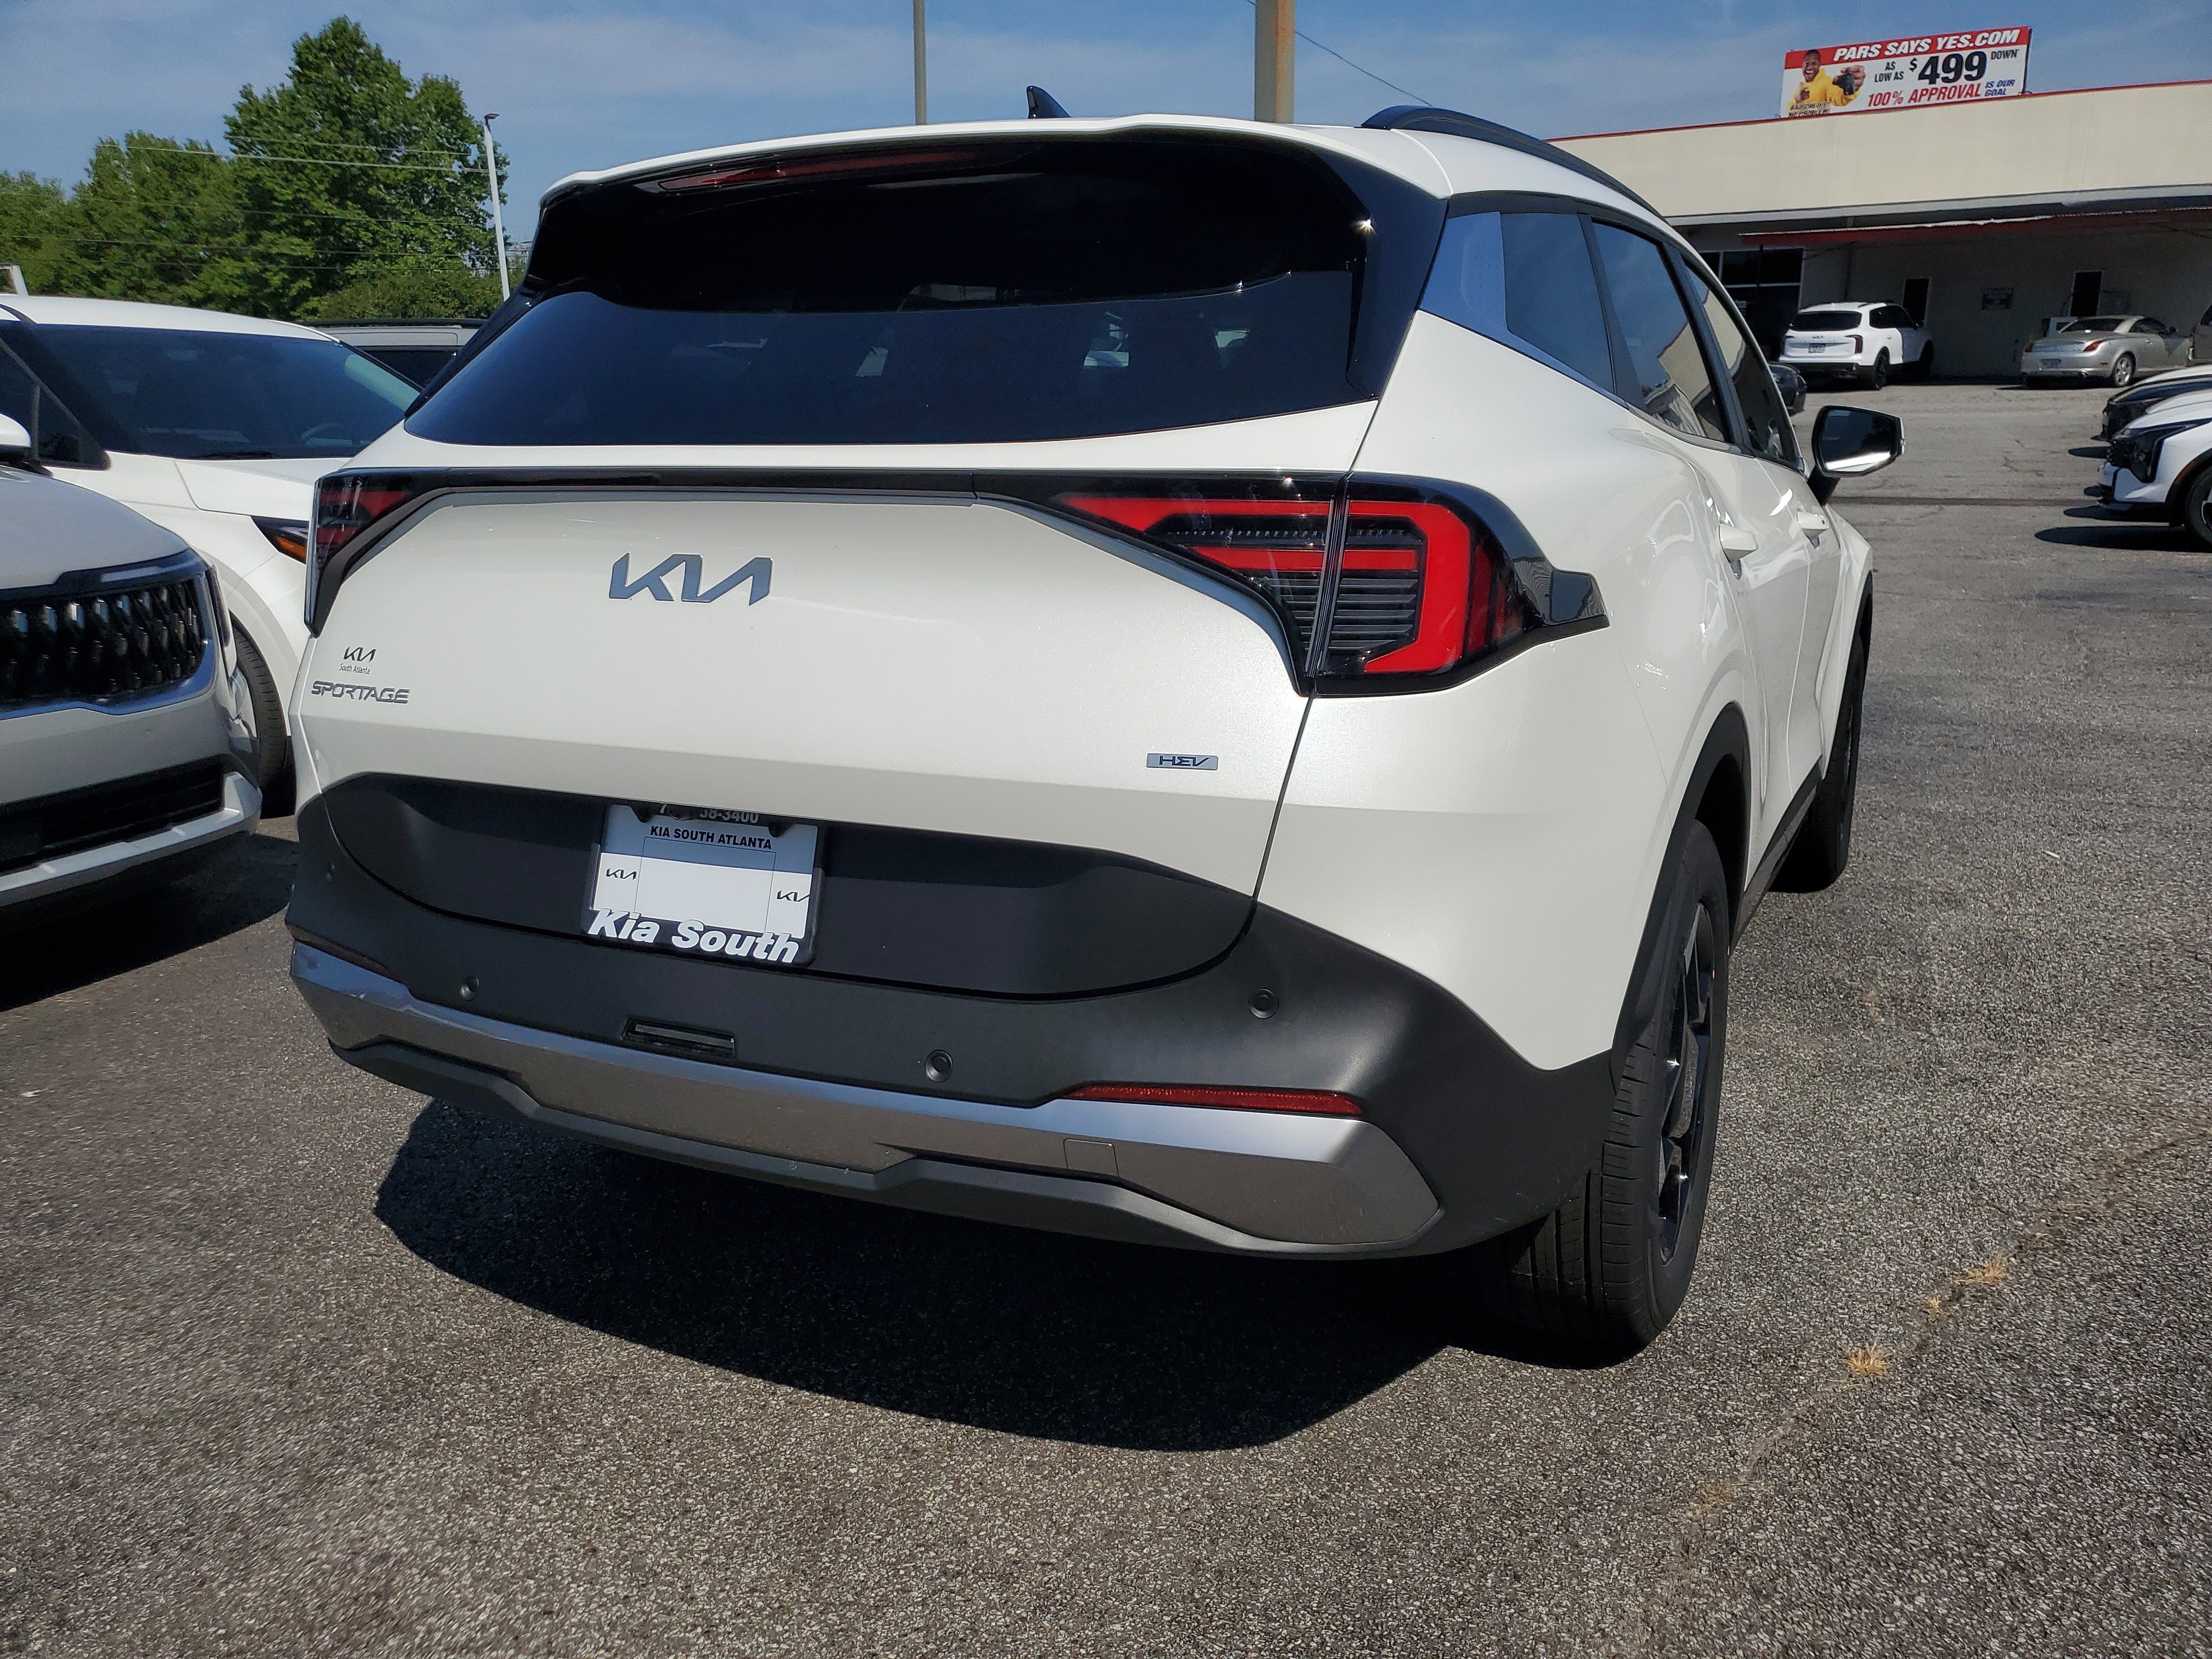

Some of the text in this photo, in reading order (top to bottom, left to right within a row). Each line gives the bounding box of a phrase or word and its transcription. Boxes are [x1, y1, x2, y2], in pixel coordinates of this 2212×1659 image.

[1833, 29, 2021, 61] PARS SAYS YES.COM
[1991, 49, 2019, 60] DOWN
[1885, 61, 1896, 71] AS
[1874, 71, 1904, 83] LOW AS
[1996, 79, 2016, 87] OUR
[1868, 83, 1982, 107] 100% APPROVAL
[1984, 88, 2006, 97] GOAL
[609, 552, 773, 606] KIA
[343, 646, 376, 662] KIA
[339, 663, 370, 674] South Atlanta
[311, 680, 410, 704] SPORTAGE
[1159, 755, 1210, 766] HEV
[650, 826, 772, 849] KIA SOUTH ATLANTA
[606, 868, 637, 880] KIA
[588, 909, 799, 963] Kia South
